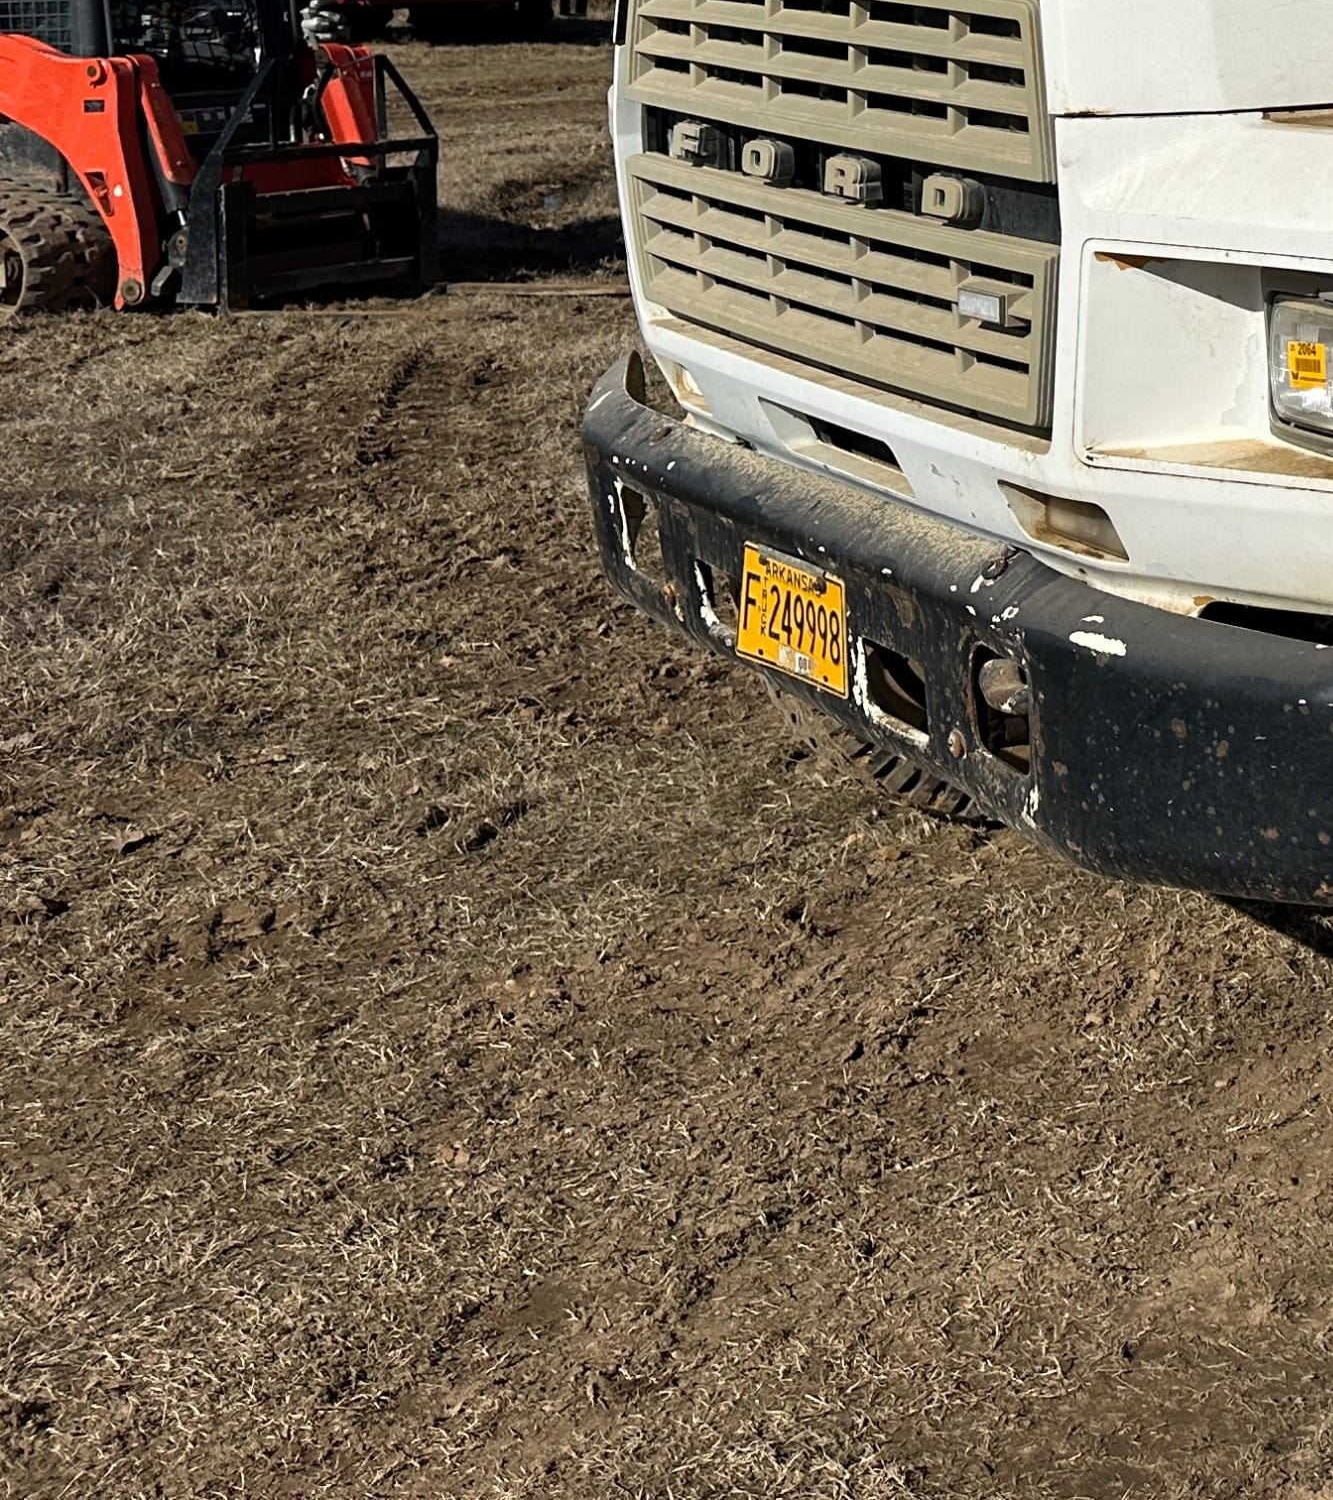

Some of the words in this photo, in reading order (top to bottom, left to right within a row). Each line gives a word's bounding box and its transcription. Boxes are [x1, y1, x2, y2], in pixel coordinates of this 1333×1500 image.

[671, 119, 972, 223] FORD
[743, 572, 761, 630] F
[768, 584, 841, 666] 249998
[760, 577, 768, 637] TRUCK
